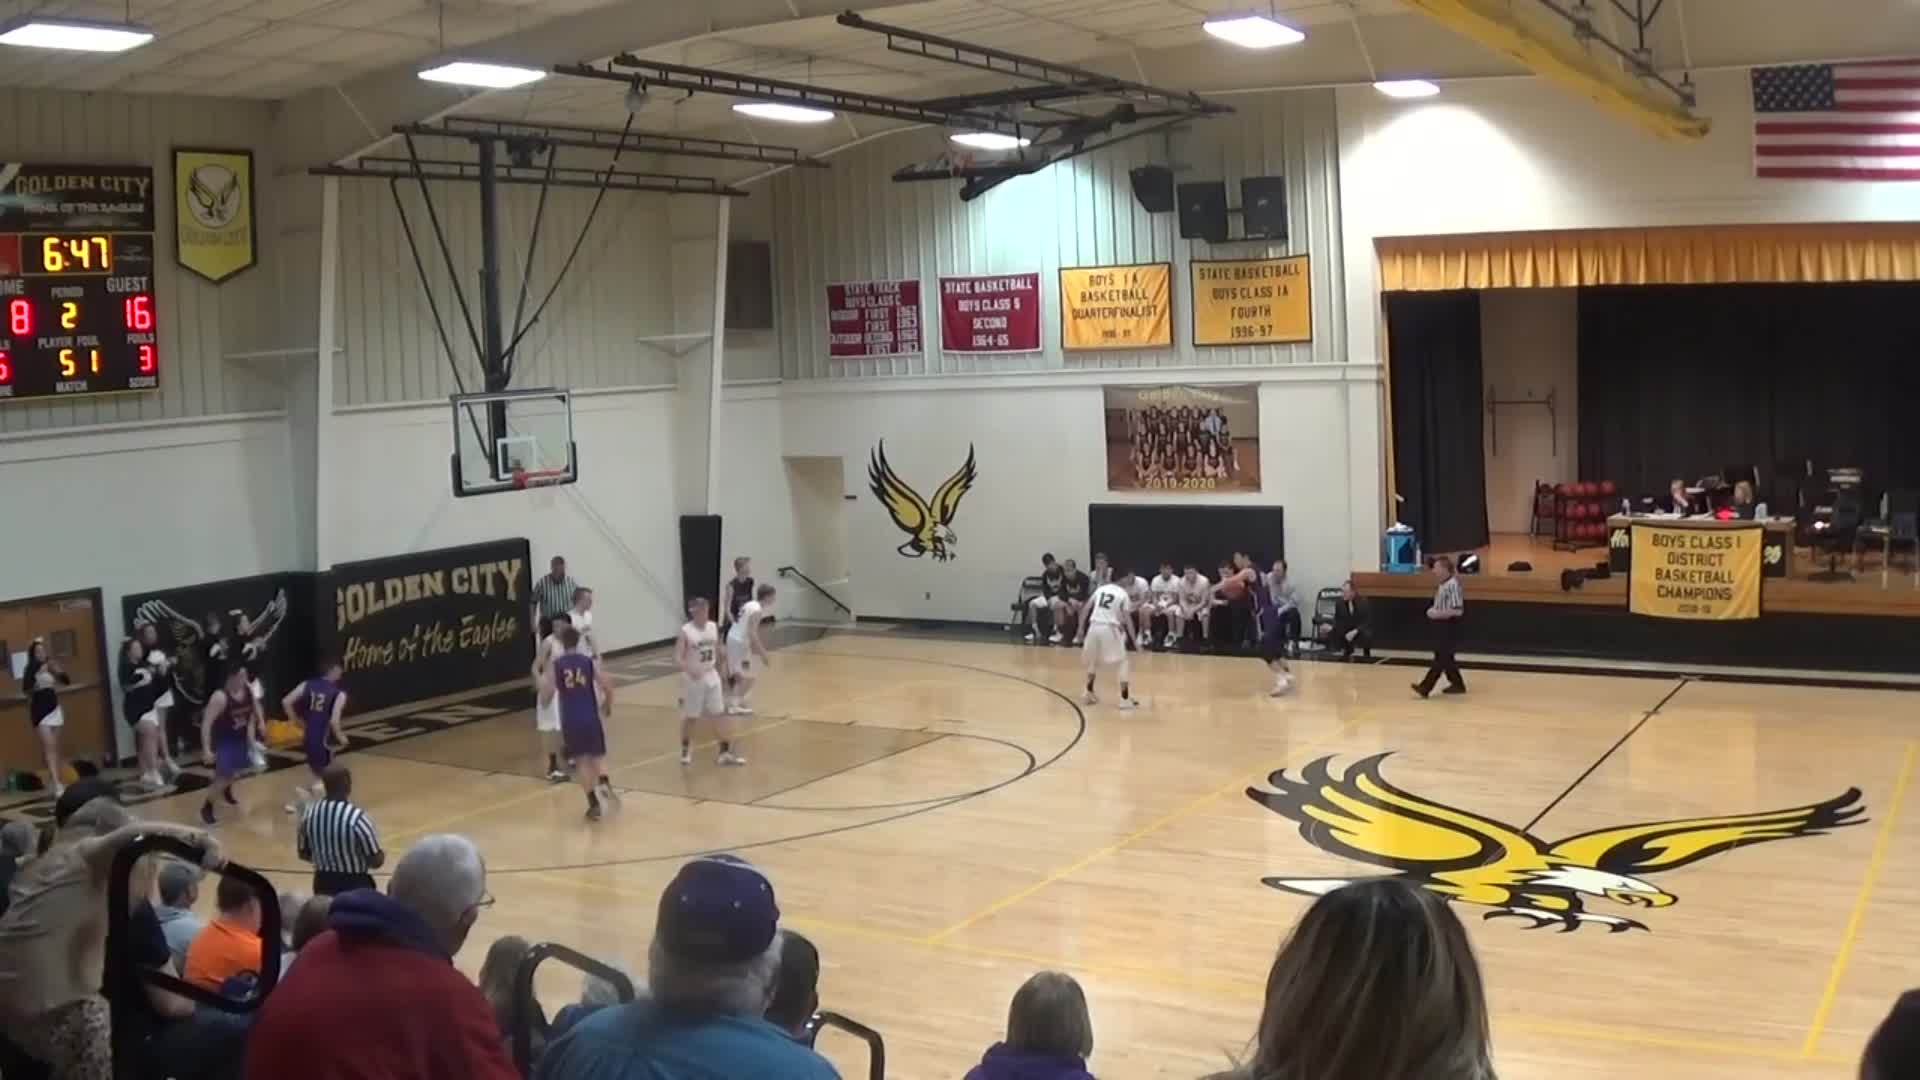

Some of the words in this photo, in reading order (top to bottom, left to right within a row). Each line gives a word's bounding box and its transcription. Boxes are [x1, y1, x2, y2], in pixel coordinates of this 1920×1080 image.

[16, 175, 95, 197] GOLDEN
[101, 175, 150, 198] CITY
[43, 236, 109, 271] 6:47
[1089, 274, 1115, 287] BOYS
[1199, 267, 1231, 281] STATE
[1234, 263, 1301, 280] BASKETBALL
[106, 277, 148, 293] GUEST
[944, 280, 972, 295] STATE
[974, 276, 1033, 294] BASKETBALL
[1212, 287, 1237, 300] BOYS
[1240, 286, 1273, 299] CLASS
[1080, 287, 1149, 302] BASKETBALL
[125, 296, 152, 330] 16
[958, 299, 980, 312] BOYS
[982, 298, 1011, 311] CLASS
[1072, 304, 1158, 320] QUARTERFINALIST
[1231, 304, 1272, 320] FOURTH
[10, 299, 30, 336] 8
[61, 302, 77, 329] 2
[973, 316, 1008, 330] SECOND
[1231, 325, 1273, 339] 1996-97
[139, 345, 153, 371] 3
[1145, 477, 1216, 489] 2019-2020
[1652, 533, 1685, 549] BOYS
[1690, 534, 1733, 550] CLASS
[1667, 552, 1725, 567] DISTRICT
[451, 558, 522, 601] CITY
[1655, 568, 1735, 584] BASKETBALL
[1098, 591, 1115, 610] 12
[1657, 585, 1733, 601] CHAMPIONS
[343, 636, 393, 673] Home
[400, 624, 421, 662] of
[423, 620, 454, 657] the
[459, 610, 517, 659] Eagles
[563, 667, 587, 689] 24
[310, 689, 325, 712] 12
